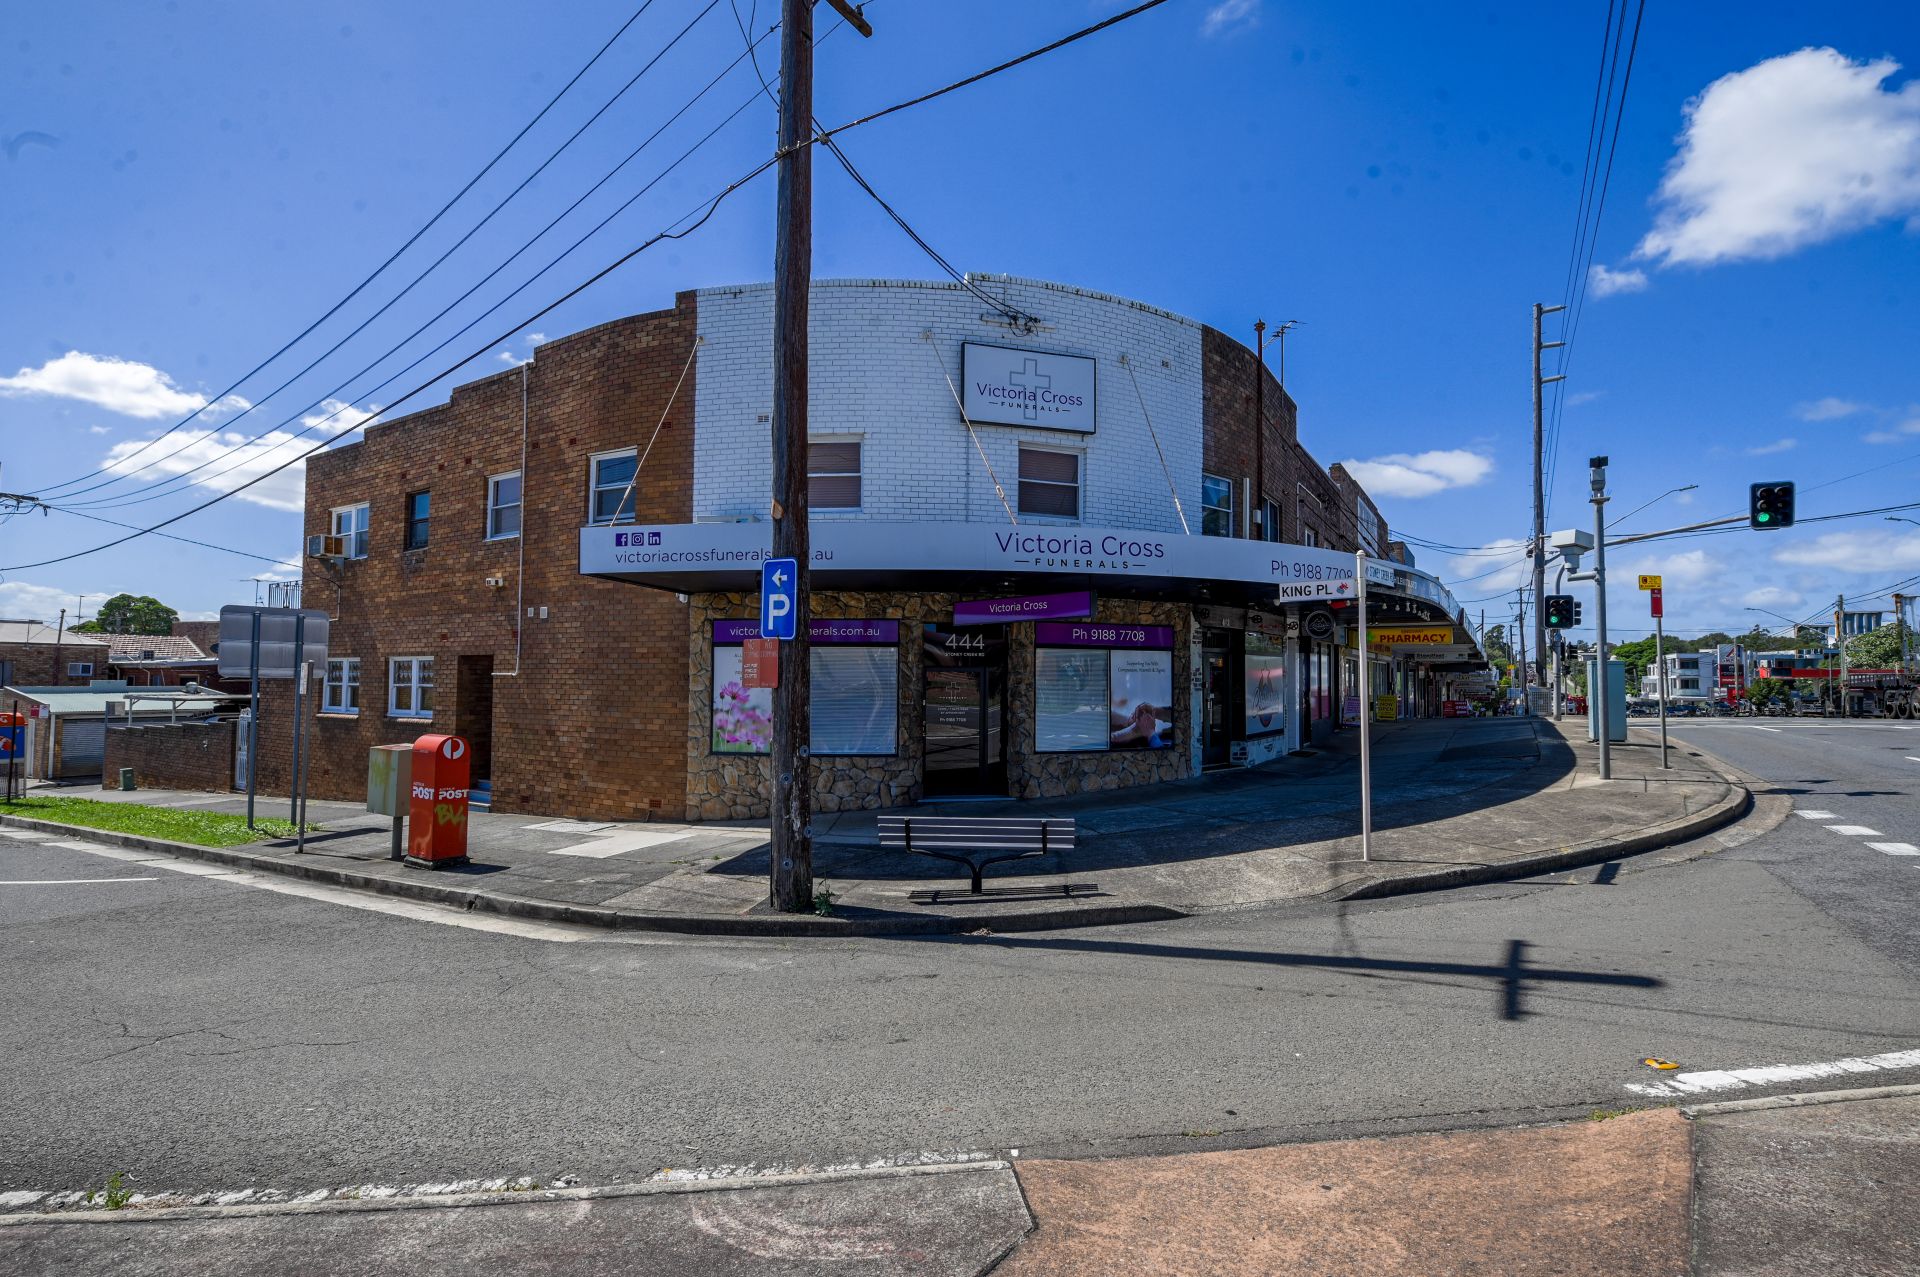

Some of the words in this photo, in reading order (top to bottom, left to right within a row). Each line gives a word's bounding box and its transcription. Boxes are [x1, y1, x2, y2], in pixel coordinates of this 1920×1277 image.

[976, 382, 1037, 401] Victoria
[1041, 390, 1083, 406] Cross
[1000, 401, 1060, 413] FUNERALS
[995, 532, 1092, 555] Victoria
[1101, 536, 1165, 558] Cross
[1035, 558, 1129, 569] FUNERALS
[1271, 560, 1289, 577] Ph
[1293, 562, 1322, 580] 9188
[1281, 585, 1312, 597] KING
[1316, 584, 1333, 595] PL
[768, 594, 791, 630] P
[989, 602, 1021, 613] Victoria
[1023, 600, 1048, 611] Cross
[945, 633, 985, 650] 444
[1072, 628, 1087, 640] Ph
[1091, 629, 1116, 641] 9188
[1119, 630, 1145, 642] 7708
[1380, 634, 1447, 643] PHARMACY
[412, 785, 435, 800] POST
[438, 788, 469, 801] POST
